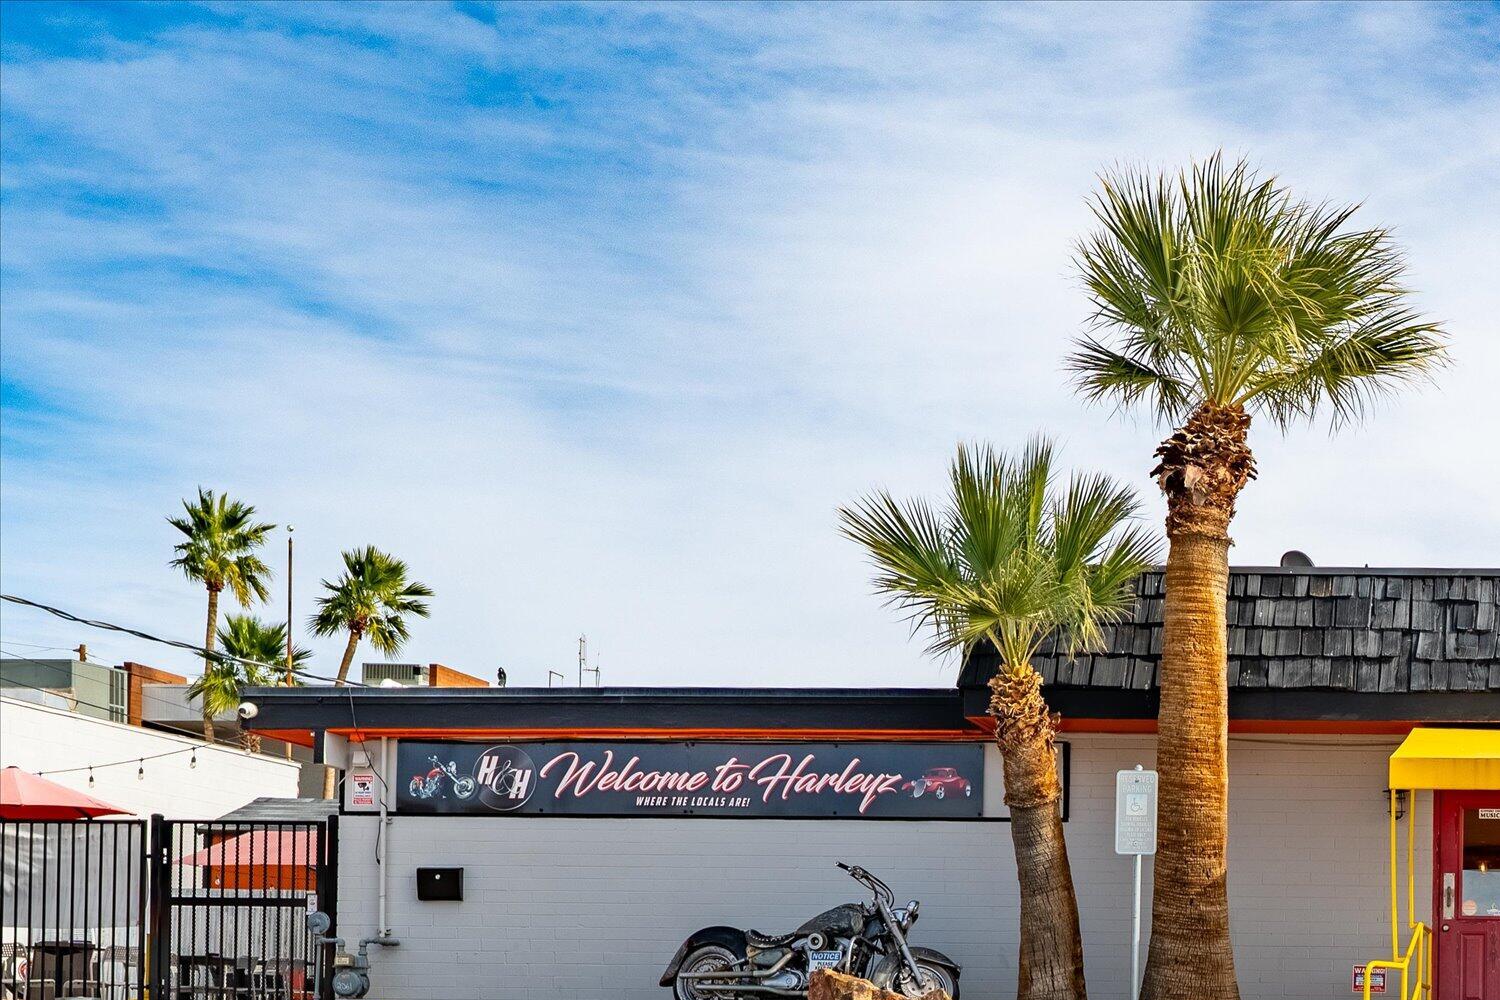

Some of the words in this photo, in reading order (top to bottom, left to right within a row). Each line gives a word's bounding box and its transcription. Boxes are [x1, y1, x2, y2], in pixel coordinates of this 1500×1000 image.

[540, 750, 709, 799] Welcome
[715, 757, 750, 793] to
[748, 753, 902, 814] Harleyz
[635, 796, 668, 806] WHERE
[671, 797, 688, 806] THE
[691, 797, 726, 807] LOCALS
[728, 797, 750, 807] ARE!
